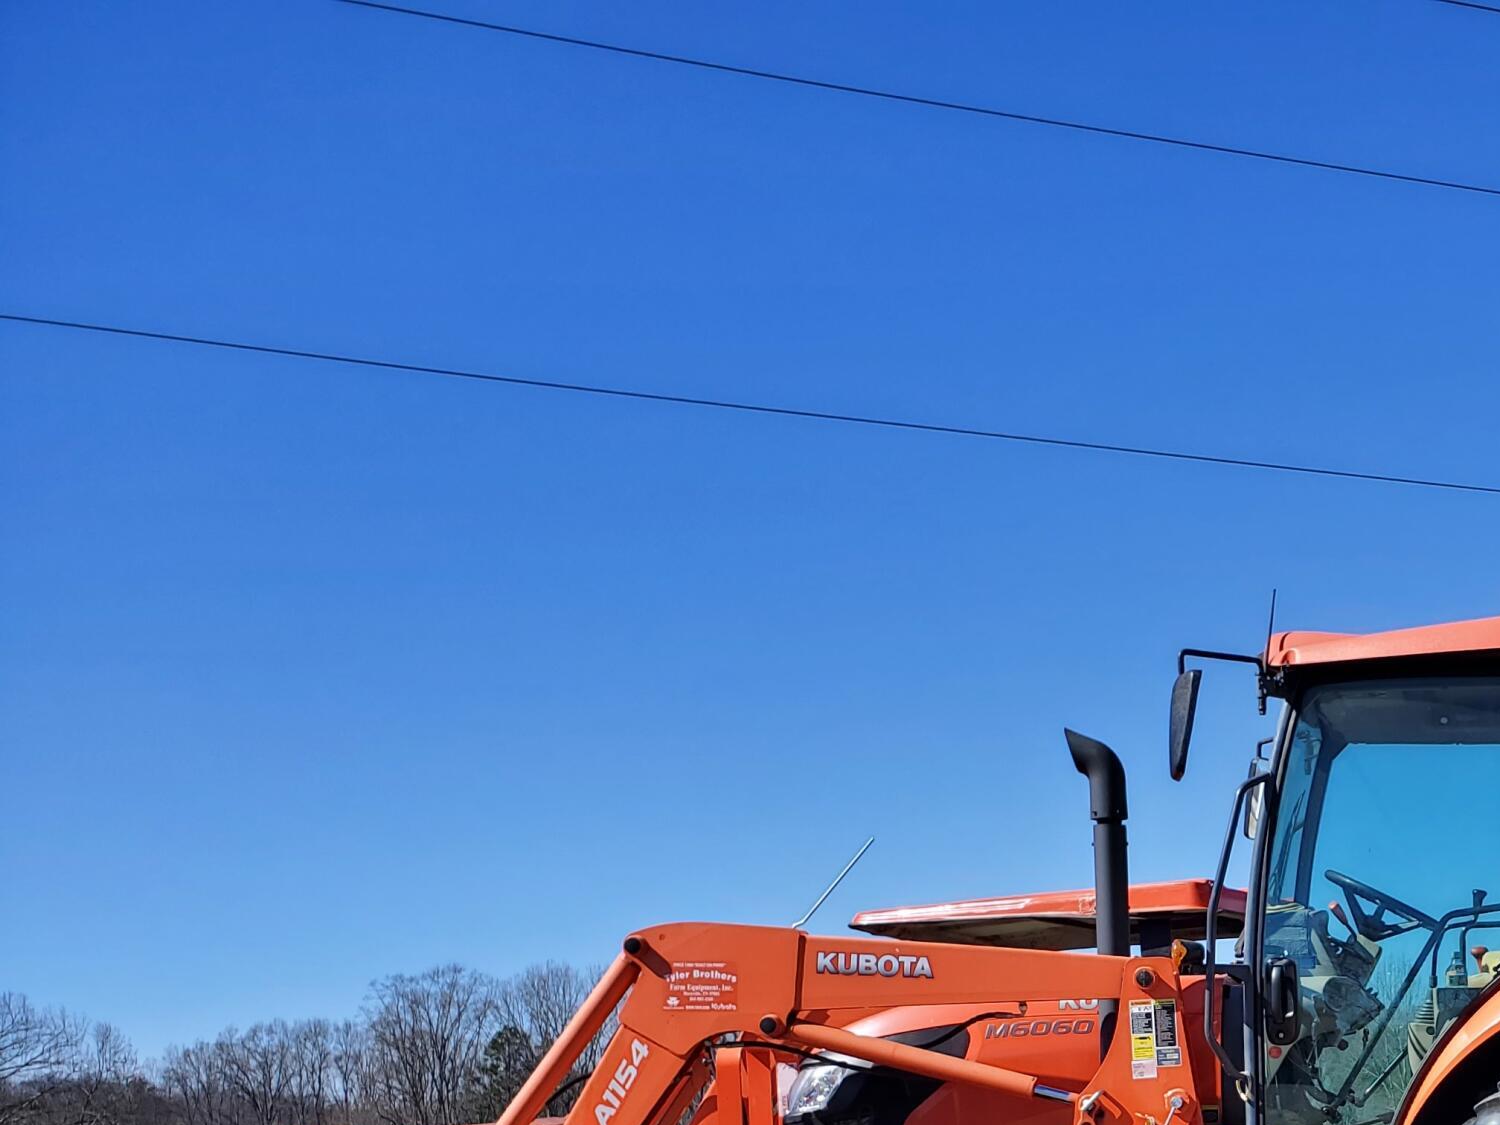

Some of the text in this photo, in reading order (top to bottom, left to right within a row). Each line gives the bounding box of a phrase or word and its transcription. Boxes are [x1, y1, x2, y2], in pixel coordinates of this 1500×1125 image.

[816, 952, 934, 978] KUBOTA
[692, 969, 737, 983] Brothers
[985, 1019, 1095, 1039] M6060
